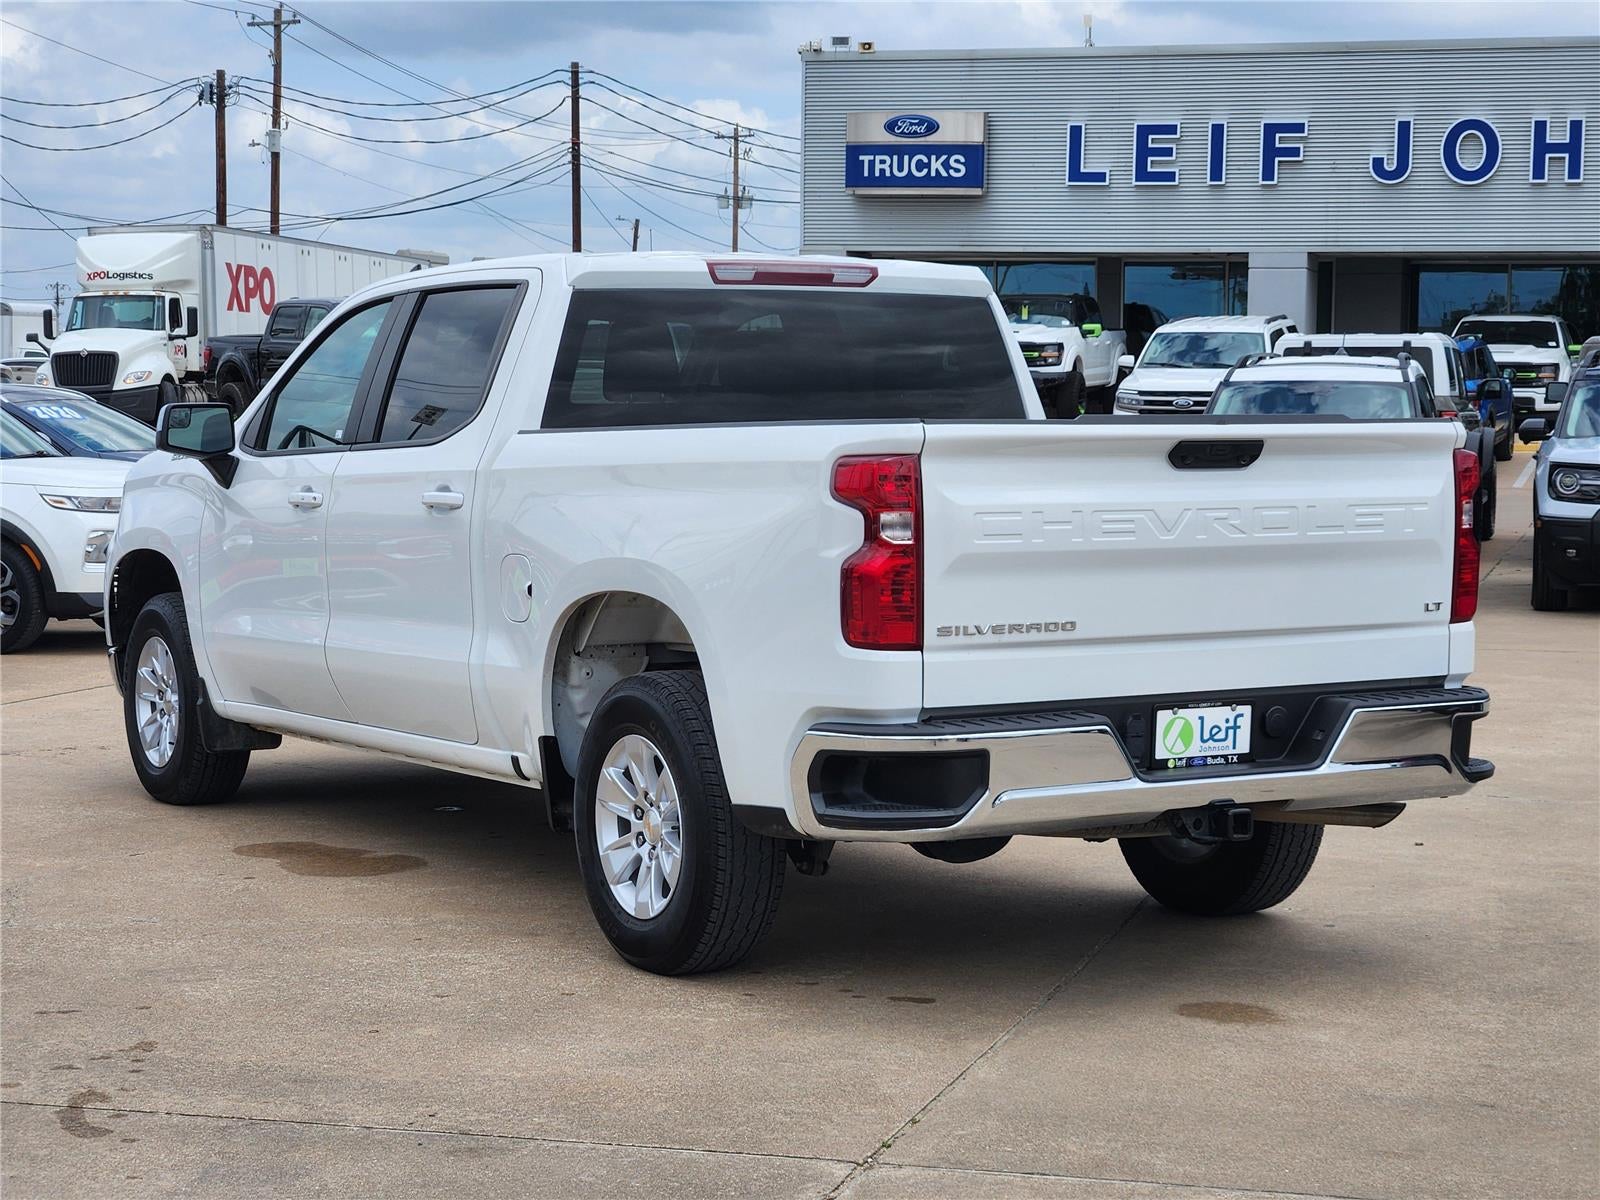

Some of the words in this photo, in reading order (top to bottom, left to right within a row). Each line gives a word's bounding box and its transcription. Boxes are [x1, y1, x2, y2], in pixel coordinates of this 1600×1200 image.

[894, 118, 927, 134] Ford
[1066, 120, 1308, 187] LEIF
[1369, 116, 1586, 185] JOH
[859, 154, 966, 177] TRUCKS
[225, 262, 275, 315] XPO
[26, 406, 83, 419] 2020
[974, 502, 1430, 544] CHEVROLET
[1424, 601, 1443, 612] LT
[936, 621, 1077, 637] SILVERADO
[1198, 713, 1244, 750] leif
[1198, 745, 1230, 753] Johnson
[1227, 755, 1239, 763] TX
